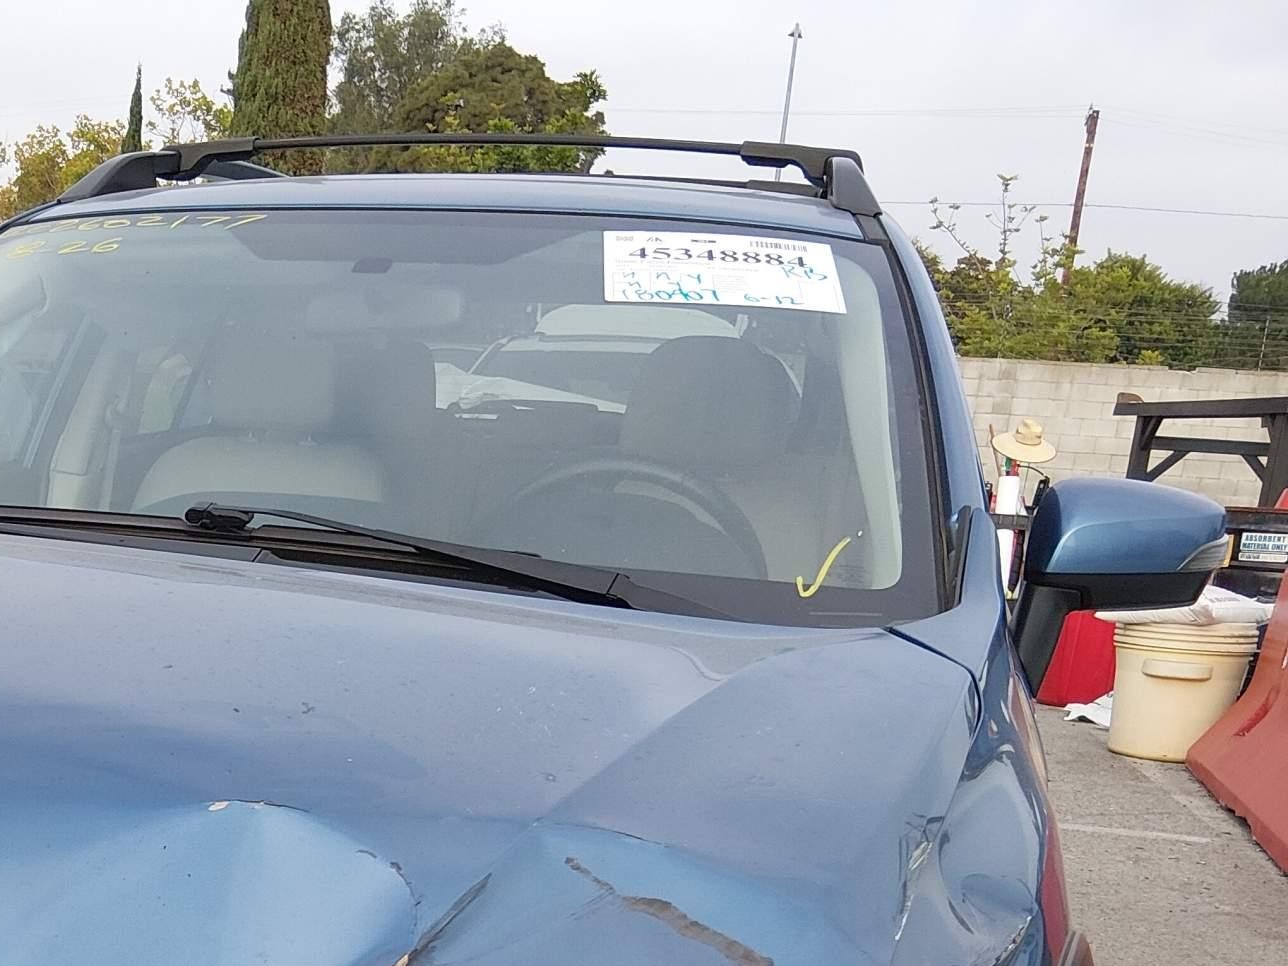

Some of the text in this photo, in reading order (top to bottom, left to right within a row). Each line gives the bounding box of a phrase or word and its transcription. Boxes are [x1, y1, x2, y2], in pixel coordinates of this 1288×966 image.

[628, 246, 807, 268] 45348884
[1242, 542, 1288, 551] MATERIAL ONLY
